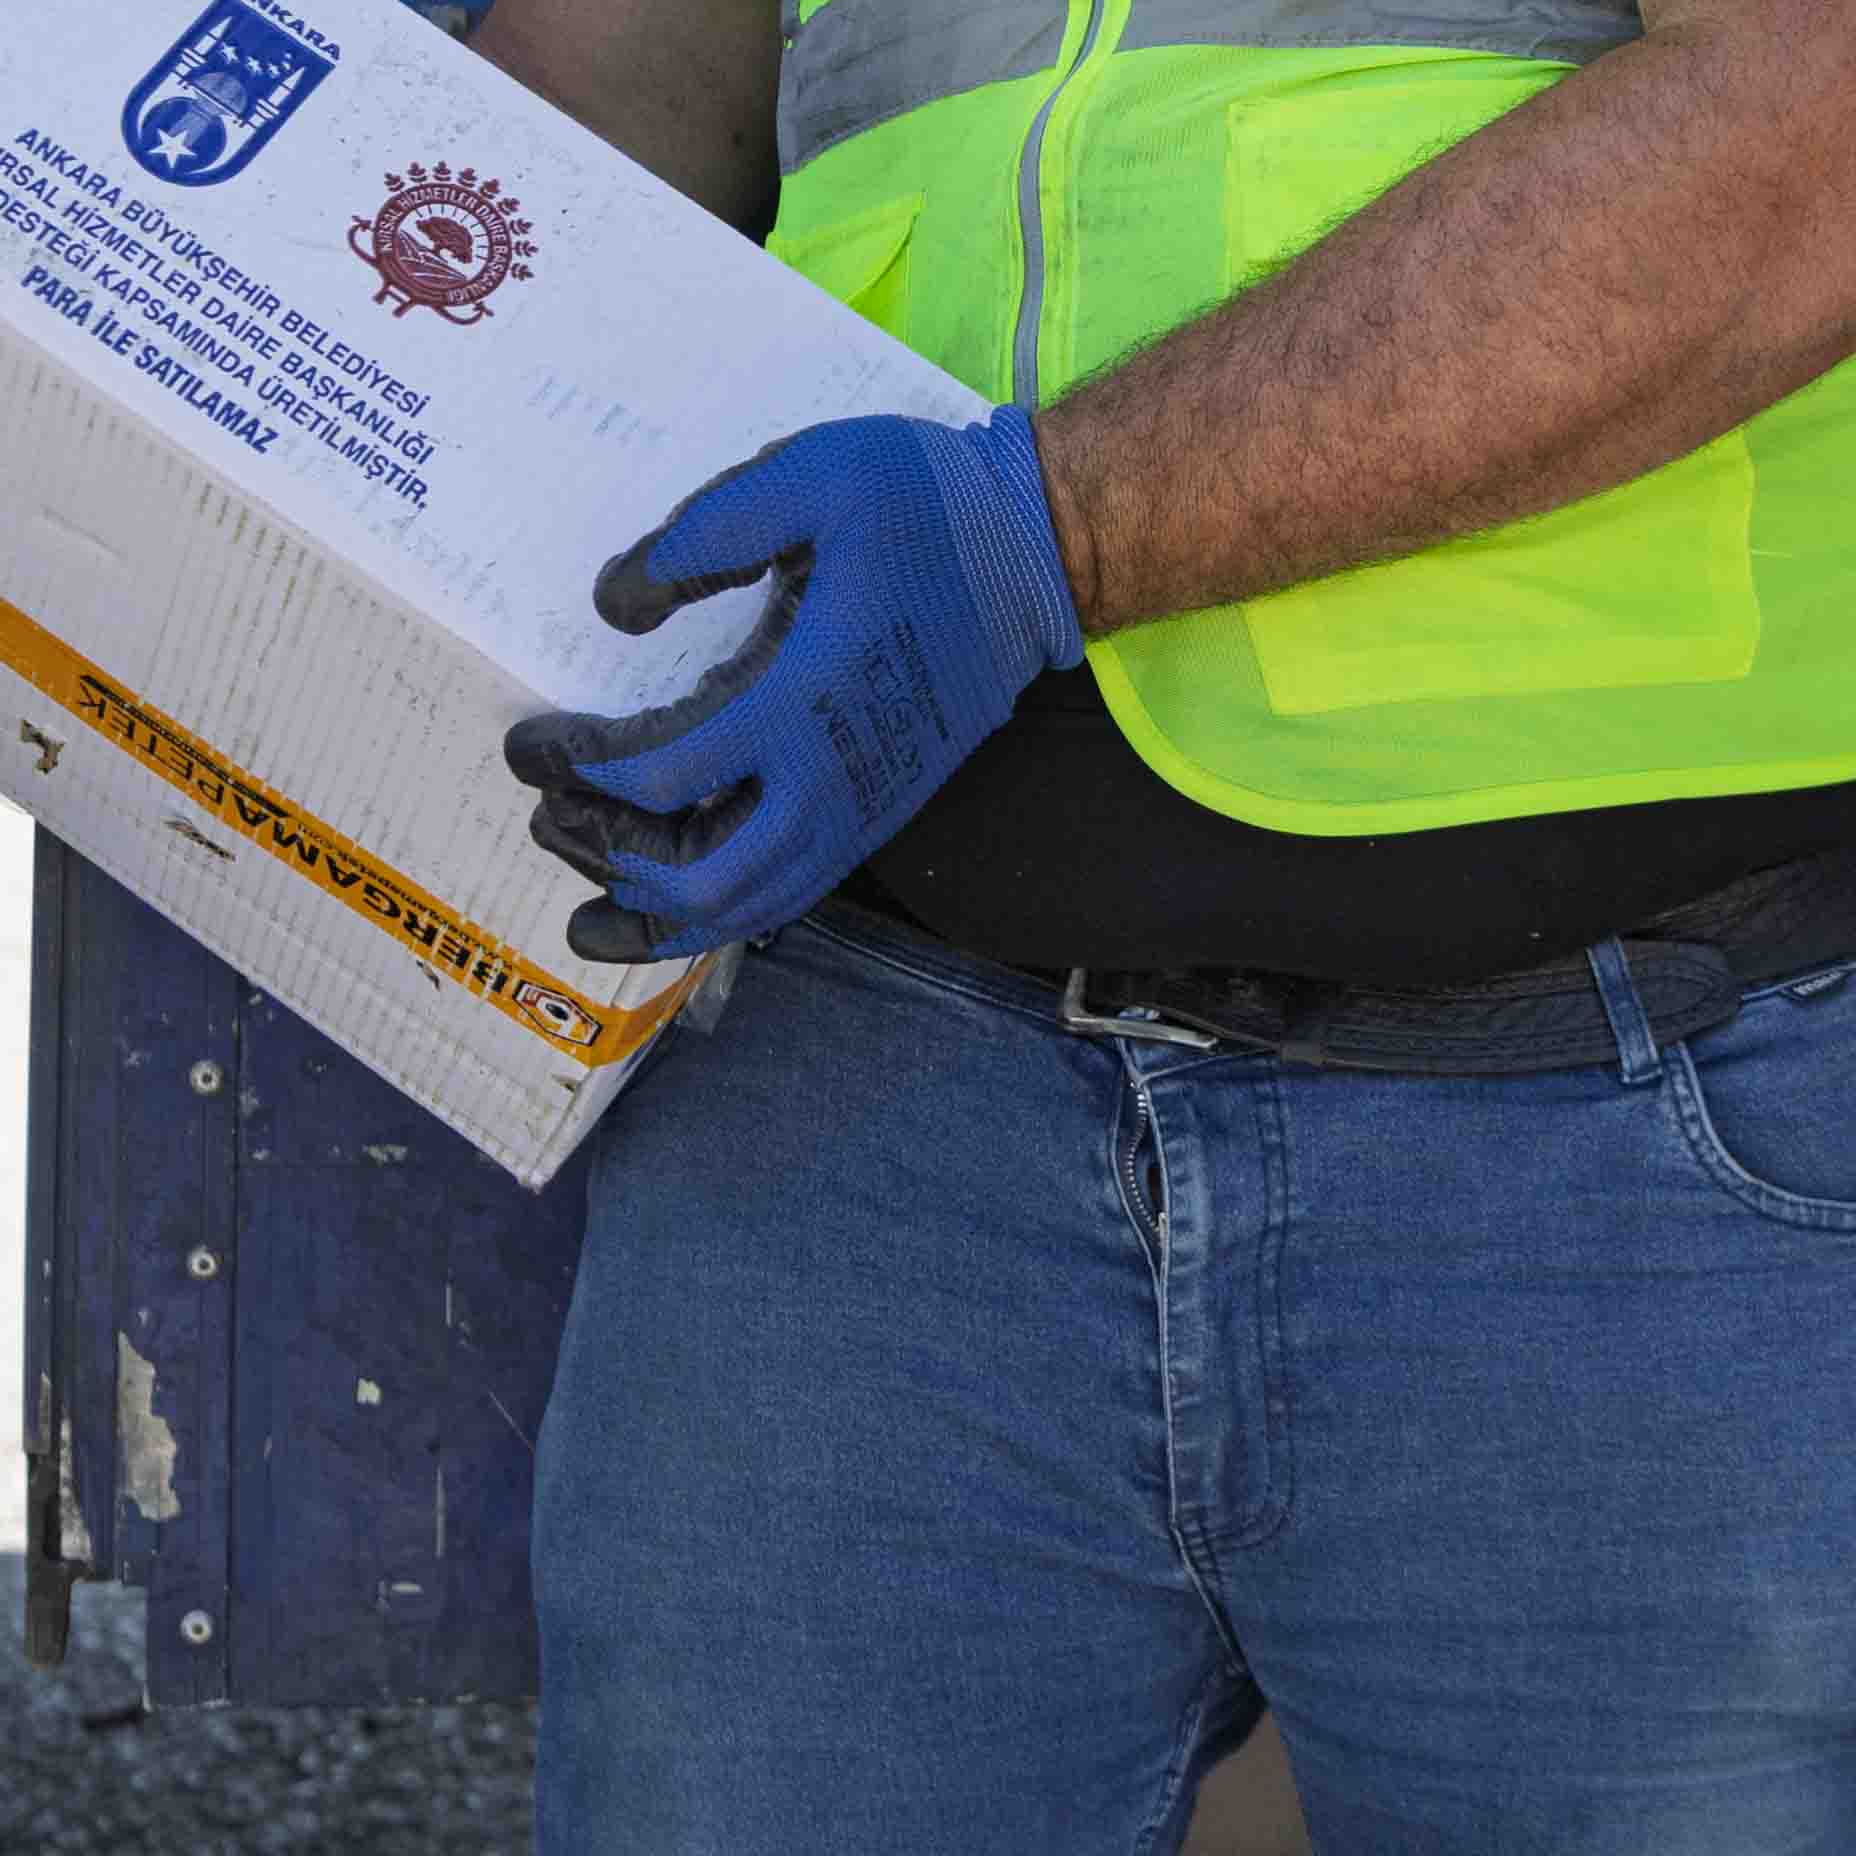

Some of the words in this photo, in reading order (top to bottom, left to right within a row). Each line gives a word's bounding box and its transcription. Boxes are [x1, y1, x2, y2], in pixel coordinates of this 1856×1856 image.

[15, 129, 121, 208] ANKARA
[121, 200, 280, 318] BÜYÜKŞEHİR
[280, 310, 430, 418] BELEDİYESİ
[21, 265, 93, 326] PARA
[91, 310, 140, 355] İLE
[135, 345, 279, 453] SATILAMAZ
[61, 200, 206, 304] HİZMETLER
[200, 297, 282, 360] DAİRE
[279, 352, 434, 464] BAŞKANLIĞI
[93, 264, 255, 387] KAPSAMINDA
[258, 376, 427, 512] ÜRETİLMİŞTİR.
